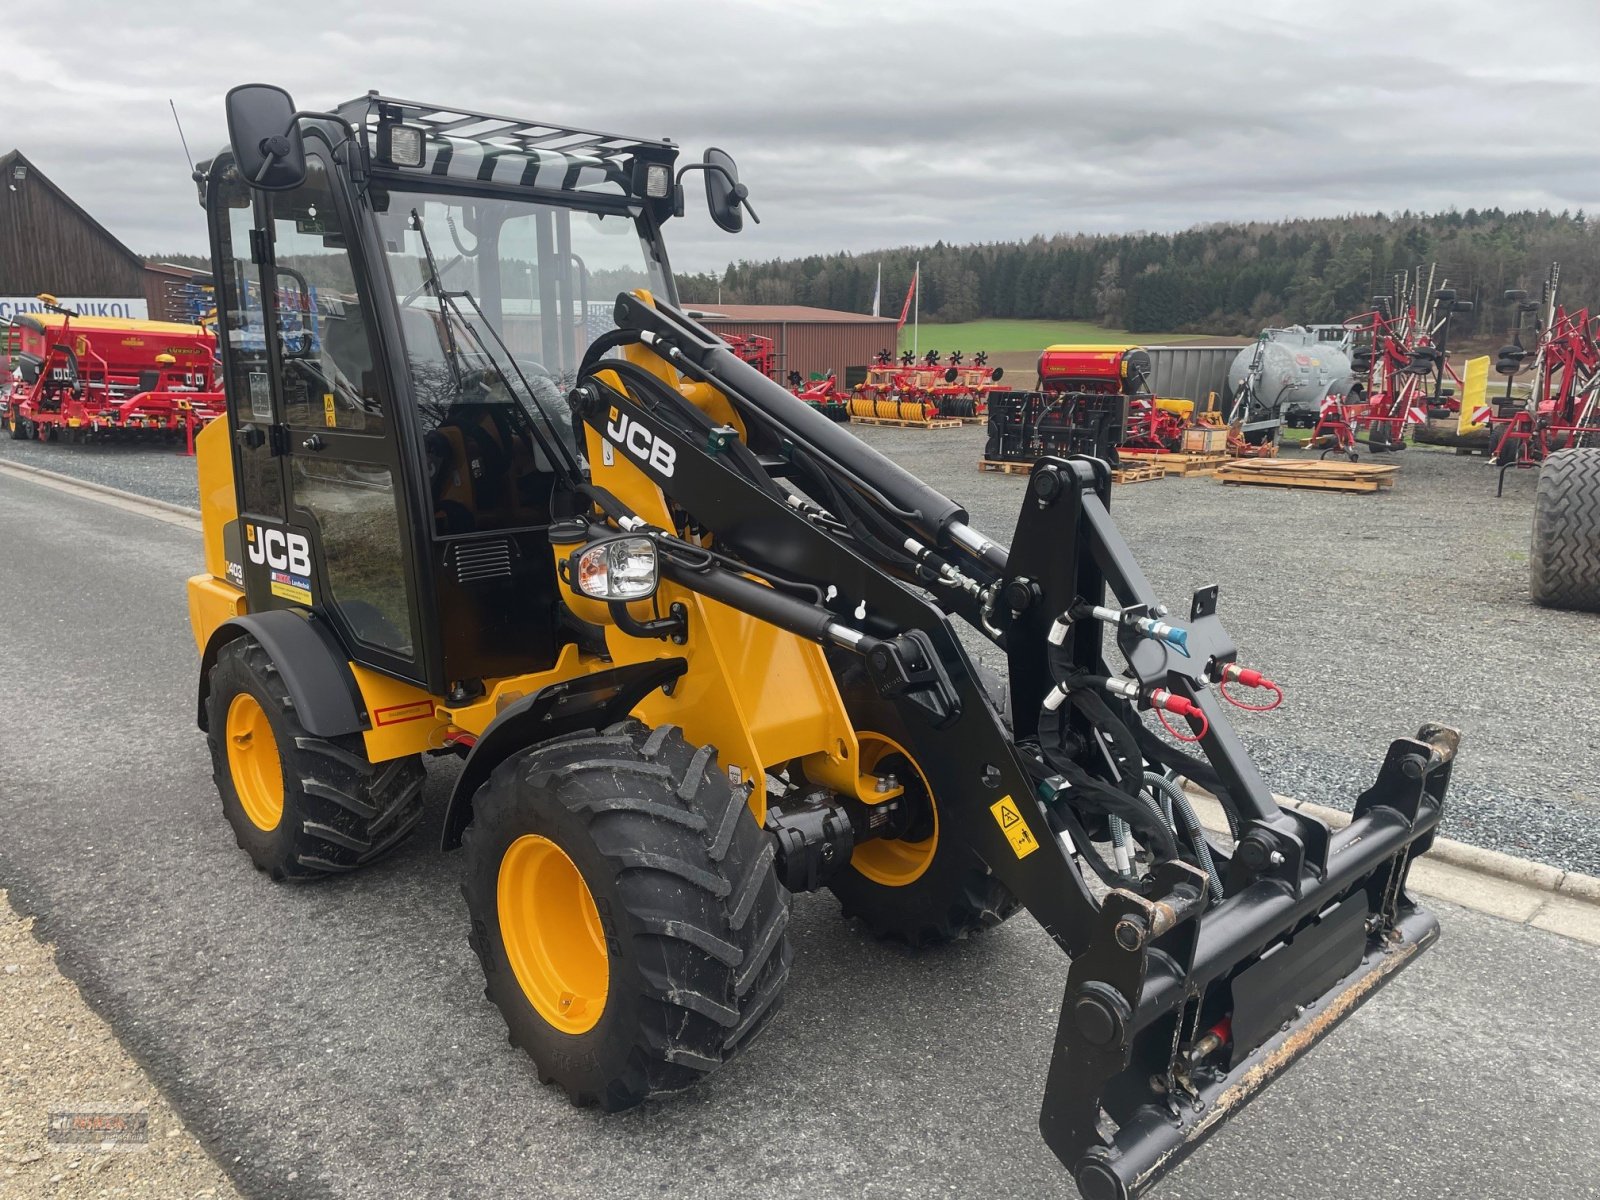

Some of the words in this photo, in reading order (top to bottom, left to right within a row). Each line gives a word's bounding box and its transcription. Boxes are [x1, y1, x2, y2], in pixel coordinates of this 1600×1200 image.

[76, 302, 136, 320] NIKOL
[607, 413, 677, 478] JCB
[248, 526, 311, 577] JCB
